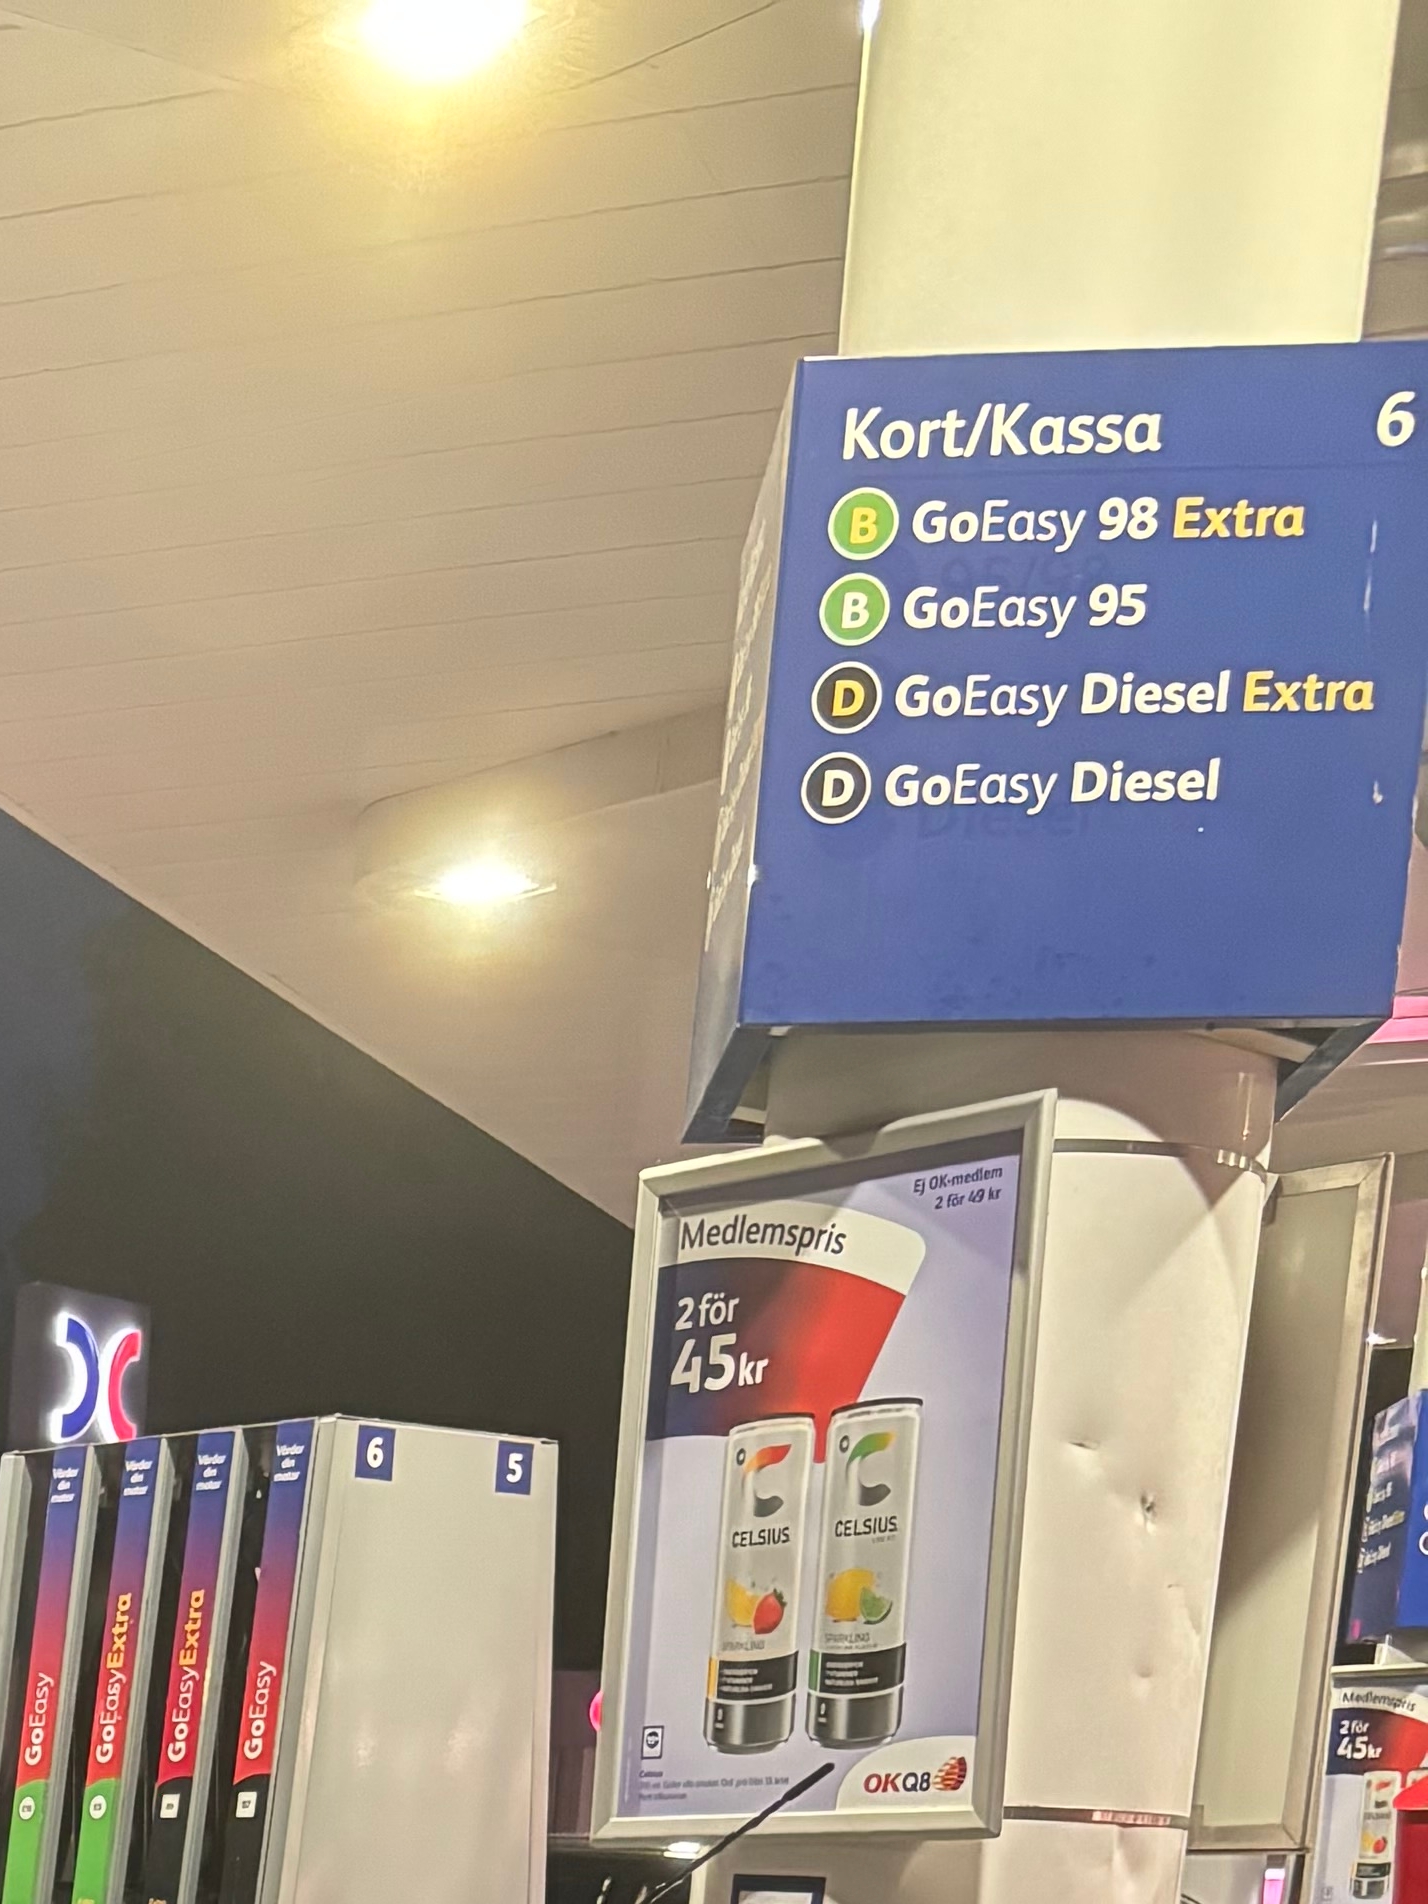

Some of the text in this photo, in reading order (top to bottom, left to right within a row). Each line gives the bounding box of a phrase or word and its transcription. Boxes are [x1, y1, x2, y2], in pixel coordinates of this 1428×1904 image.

[842, 402, 1163, 461] Kort/Kassa
[1375, 390, 1417, 447] 6
[850, 496, 1306, 553] B GoEasy 98 Extra
[841, 583, 1148, 638] B GoEasy 95
[831, 670, 1375, 727] D GoEasy Diesel Extra
[822, 757, 1221, 816] D GoEasy Diesel
[912, 1178, 926, 1195] Ej
[934, 1195, 944, 1210] 2
[946, 1192, 966, 1208] för
[988, 1186, 1003, 1201] kr
[680, 1214, 847, 1257] Medlemspris
[674, 1291, 740, 1331] 2 för
[366, 1436, 385, 1469] 6
[506, 1452, 524, 1486] 5
[732, 1527, 791, 1548] CELSIUS
[832, 1515, 898, 1537] CELSIUS
[24, 1672, 55, 1766] GoEasy
[243, 1660, 277, 1760] GoEasy
[1339, 1720, 1350, 1734] 2
